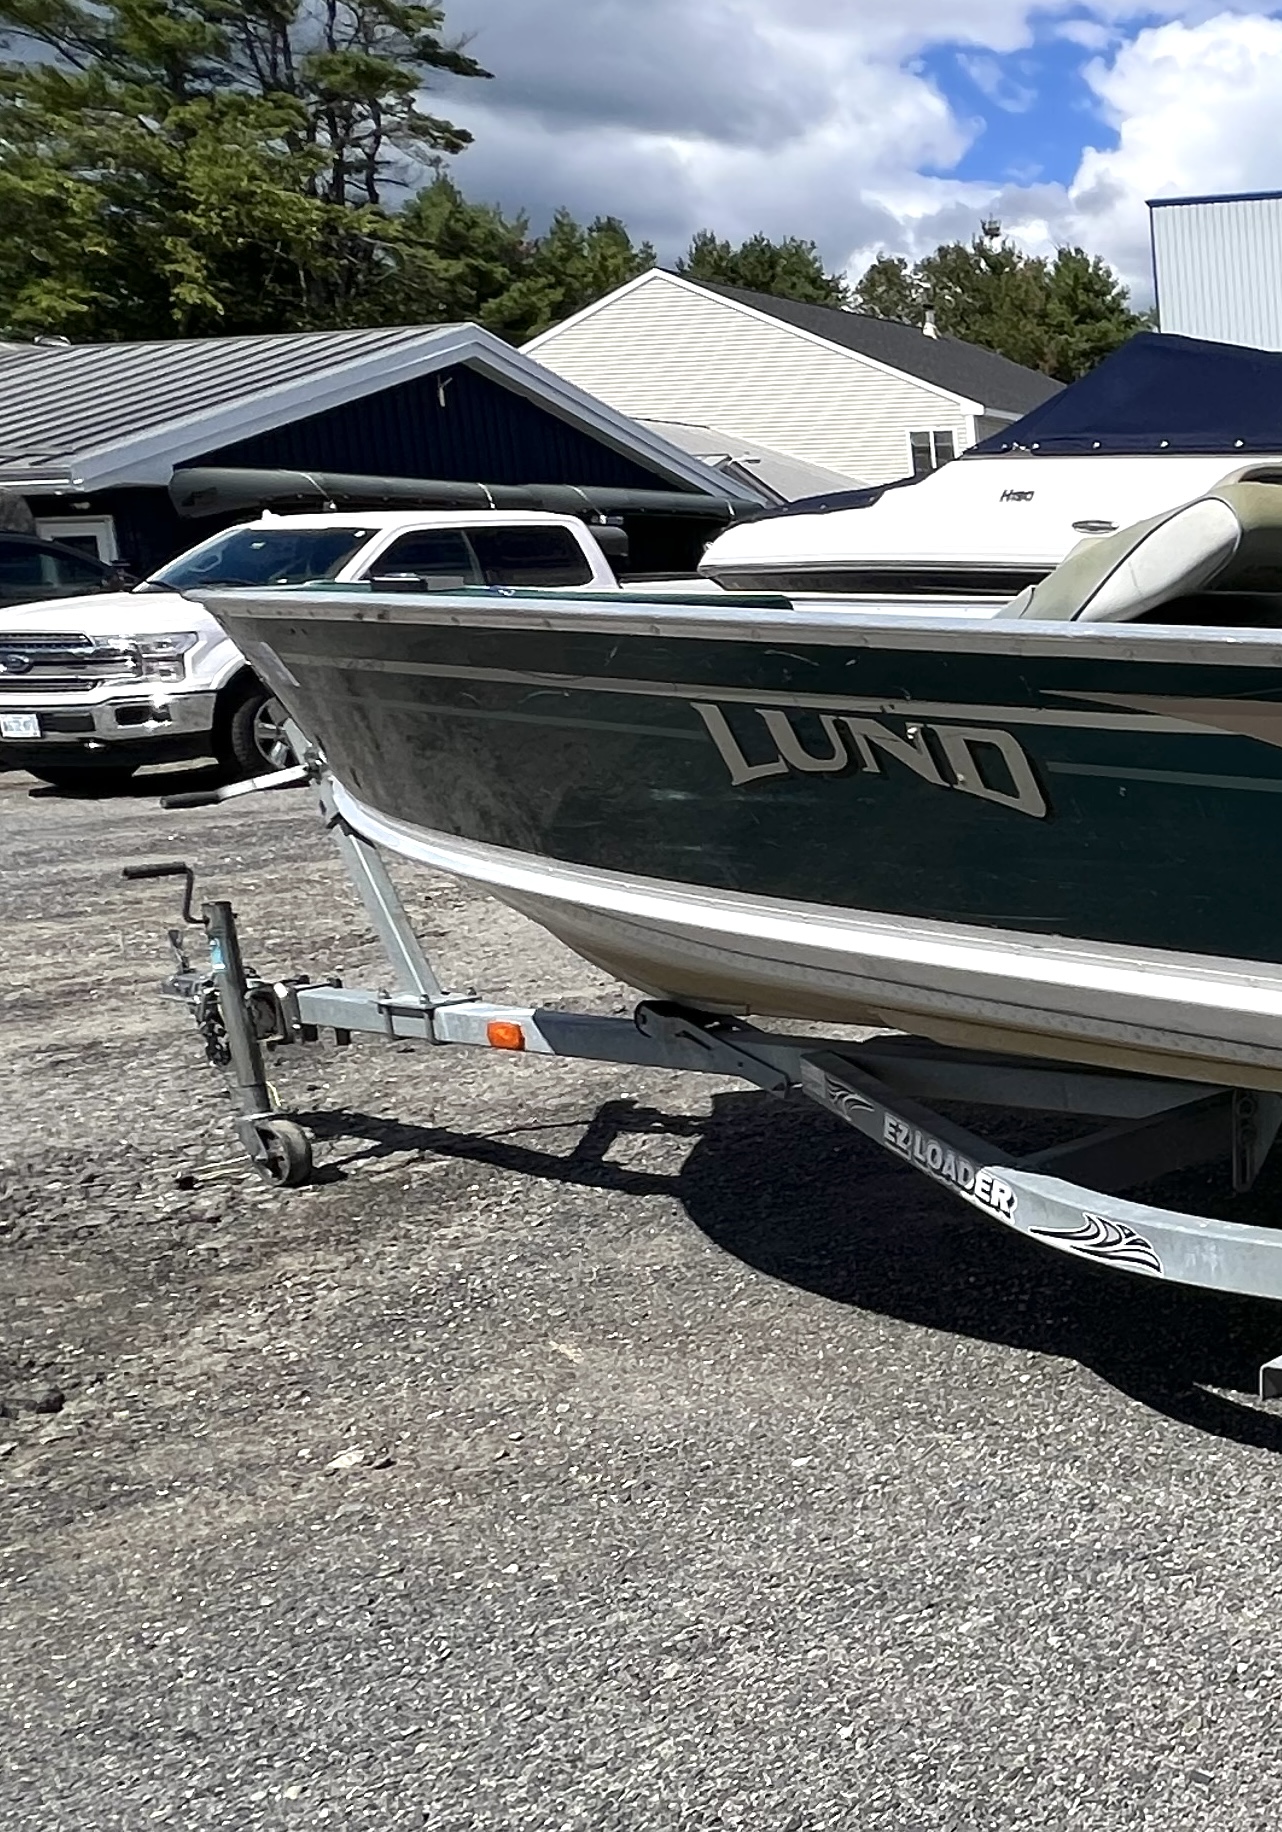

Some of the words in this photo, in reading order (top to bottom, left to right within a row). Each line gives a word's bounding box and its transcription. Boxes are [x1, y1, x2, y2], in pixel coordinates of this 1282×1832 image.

[690, 702, 1048, 819] LUND
[884, 1114, 912, 1151] EZ
[913, 1130, 1014, 1216] LOADER
